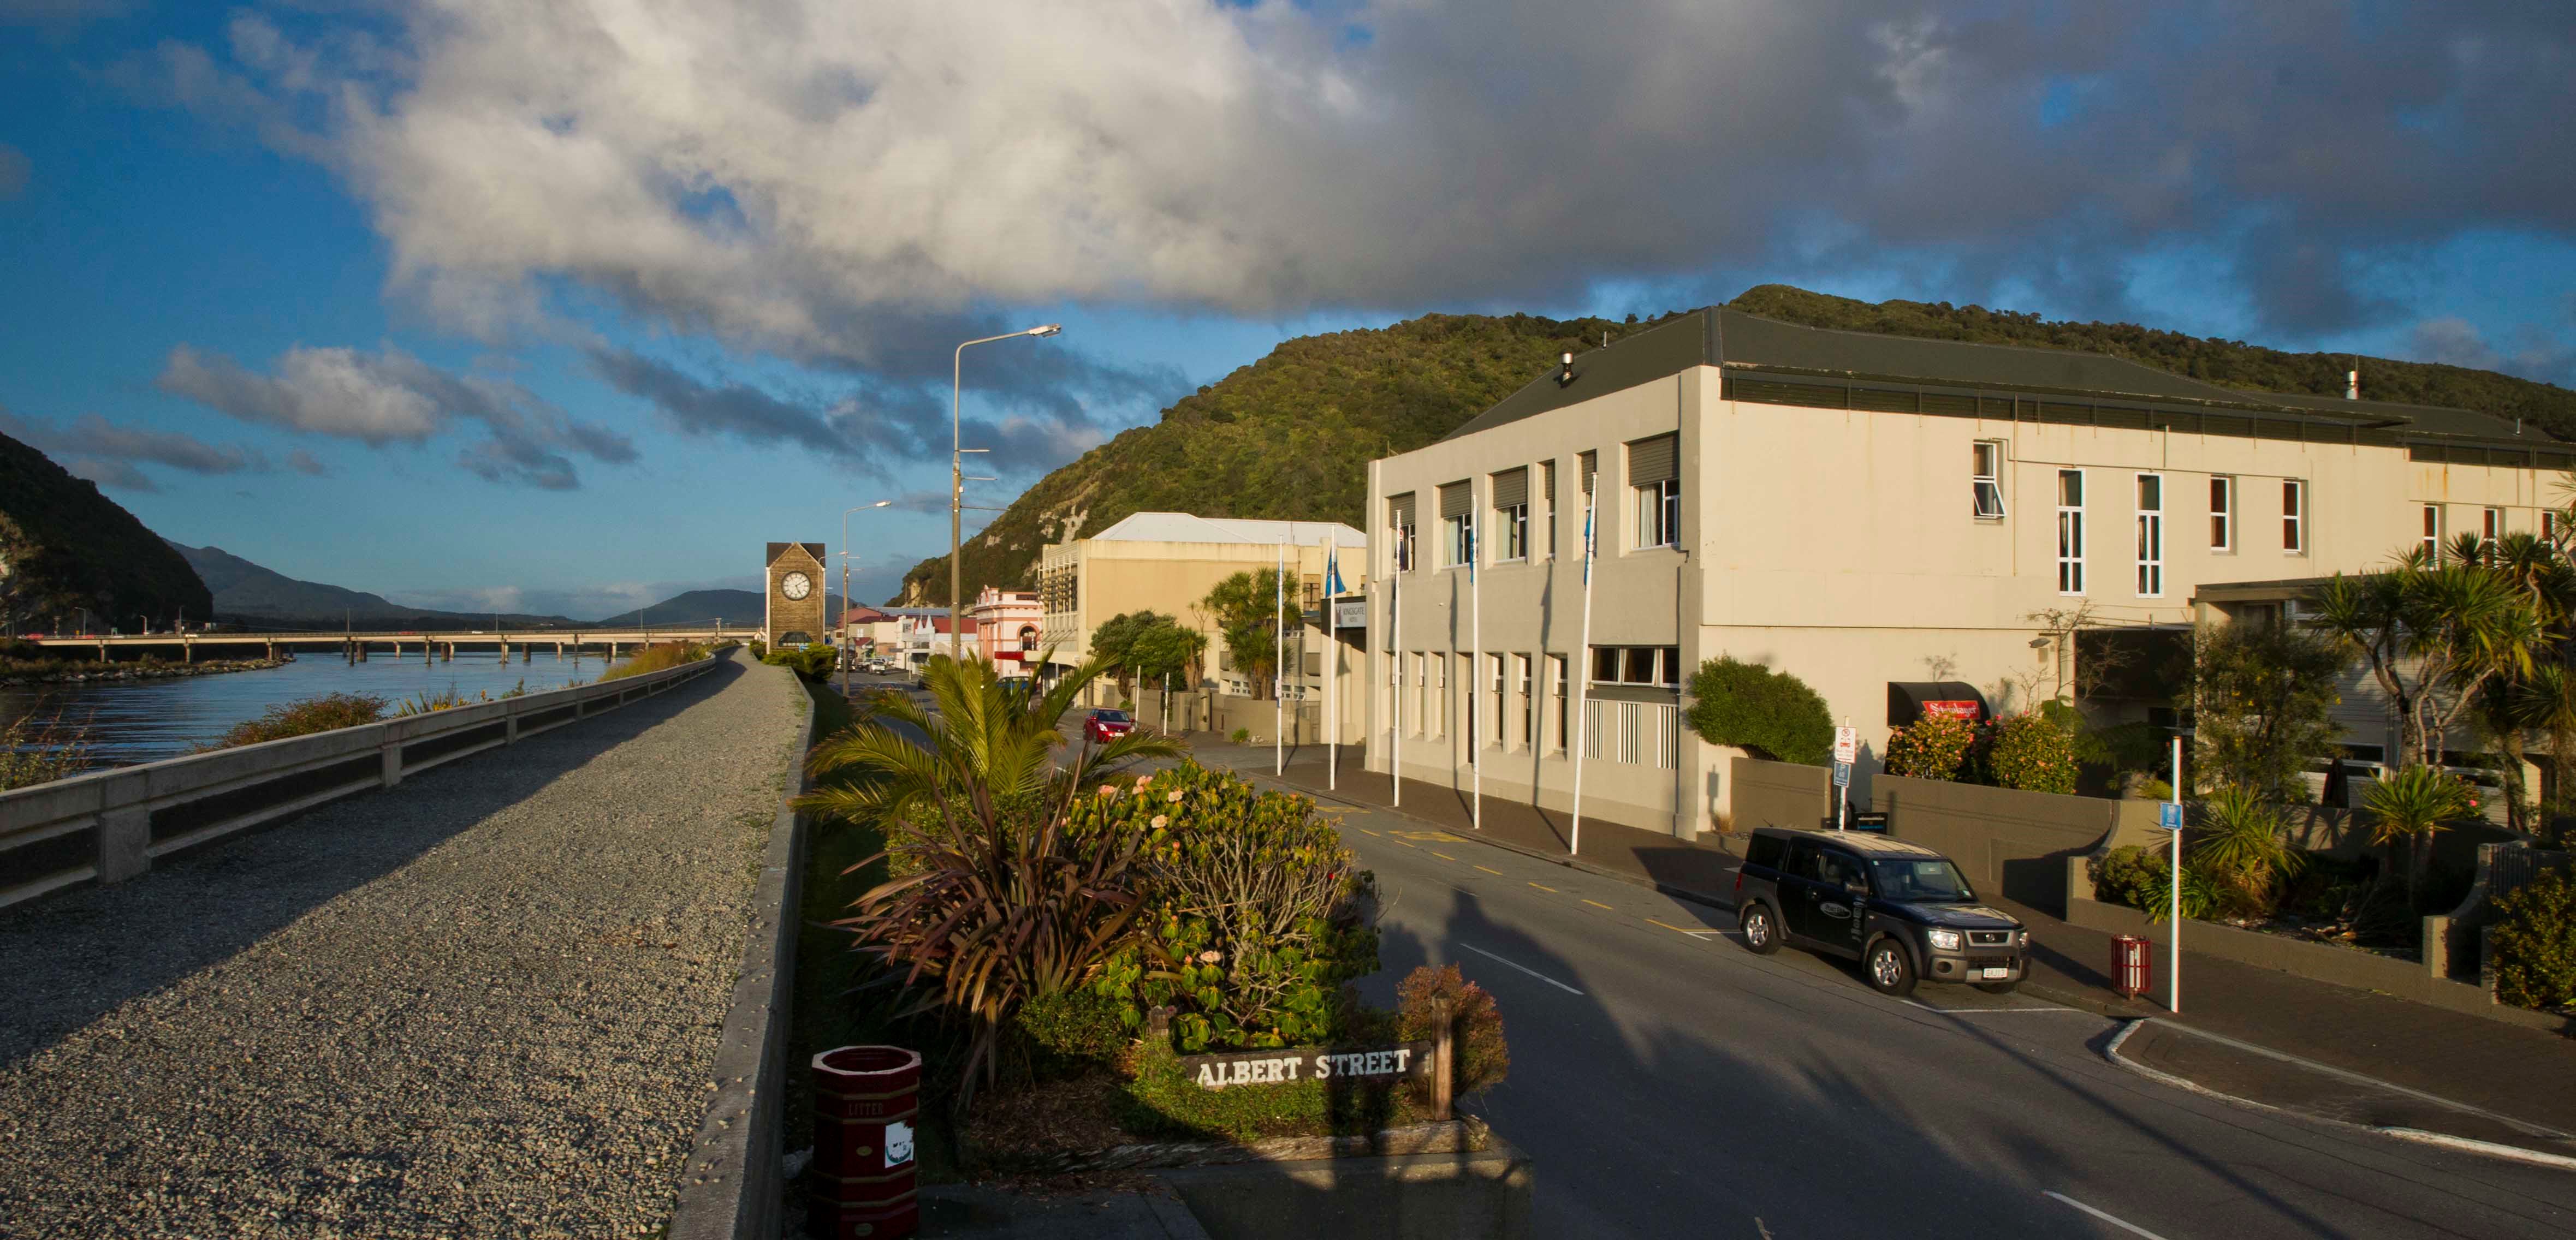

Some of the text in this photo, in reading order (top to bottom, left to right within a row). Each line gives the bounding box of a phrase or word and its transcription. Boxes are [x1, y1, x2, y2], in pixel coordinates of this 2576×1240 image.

[1343, 606, 1364, 615] KINGSGATE
[1197, 1057, 1302, 1087] ALBERT
[1315, 1049, 1410, 1080] STREET
[848, 1102, 883, 1116] LITTER
